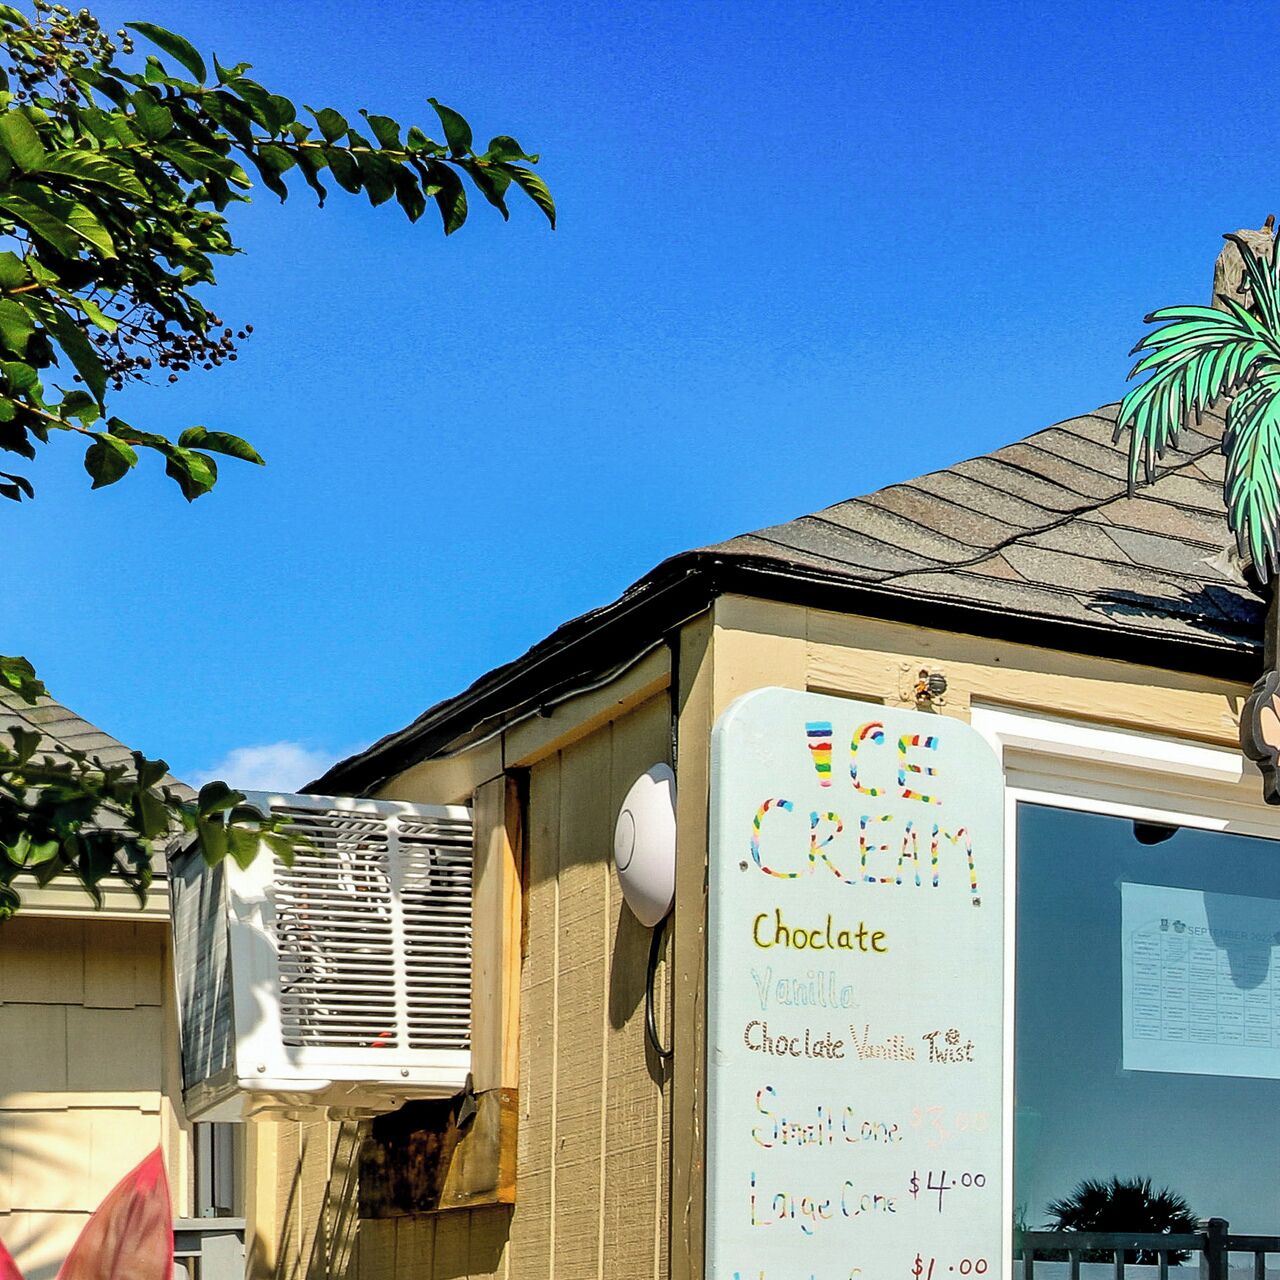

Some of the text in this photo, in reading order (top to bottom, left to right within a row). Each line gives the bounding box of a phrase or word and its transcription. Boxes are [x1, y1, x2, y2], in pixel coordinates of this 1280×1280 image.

[804, 720, 940, 806] ICE
[750, 797, 979, 894] CREAM
[753, 908, 889, 953] Choclate
[751, 965, 861, 1011] Vanilla
[744, 1019, 846, 1060] Choclate
[922, 1028, 976, 1064] Twist
[751, 1085, 833, 1149] Small
[842, 1106, 902, 1144] Cone
[750, 1170, 986, 1236] Large Cone $4.00
